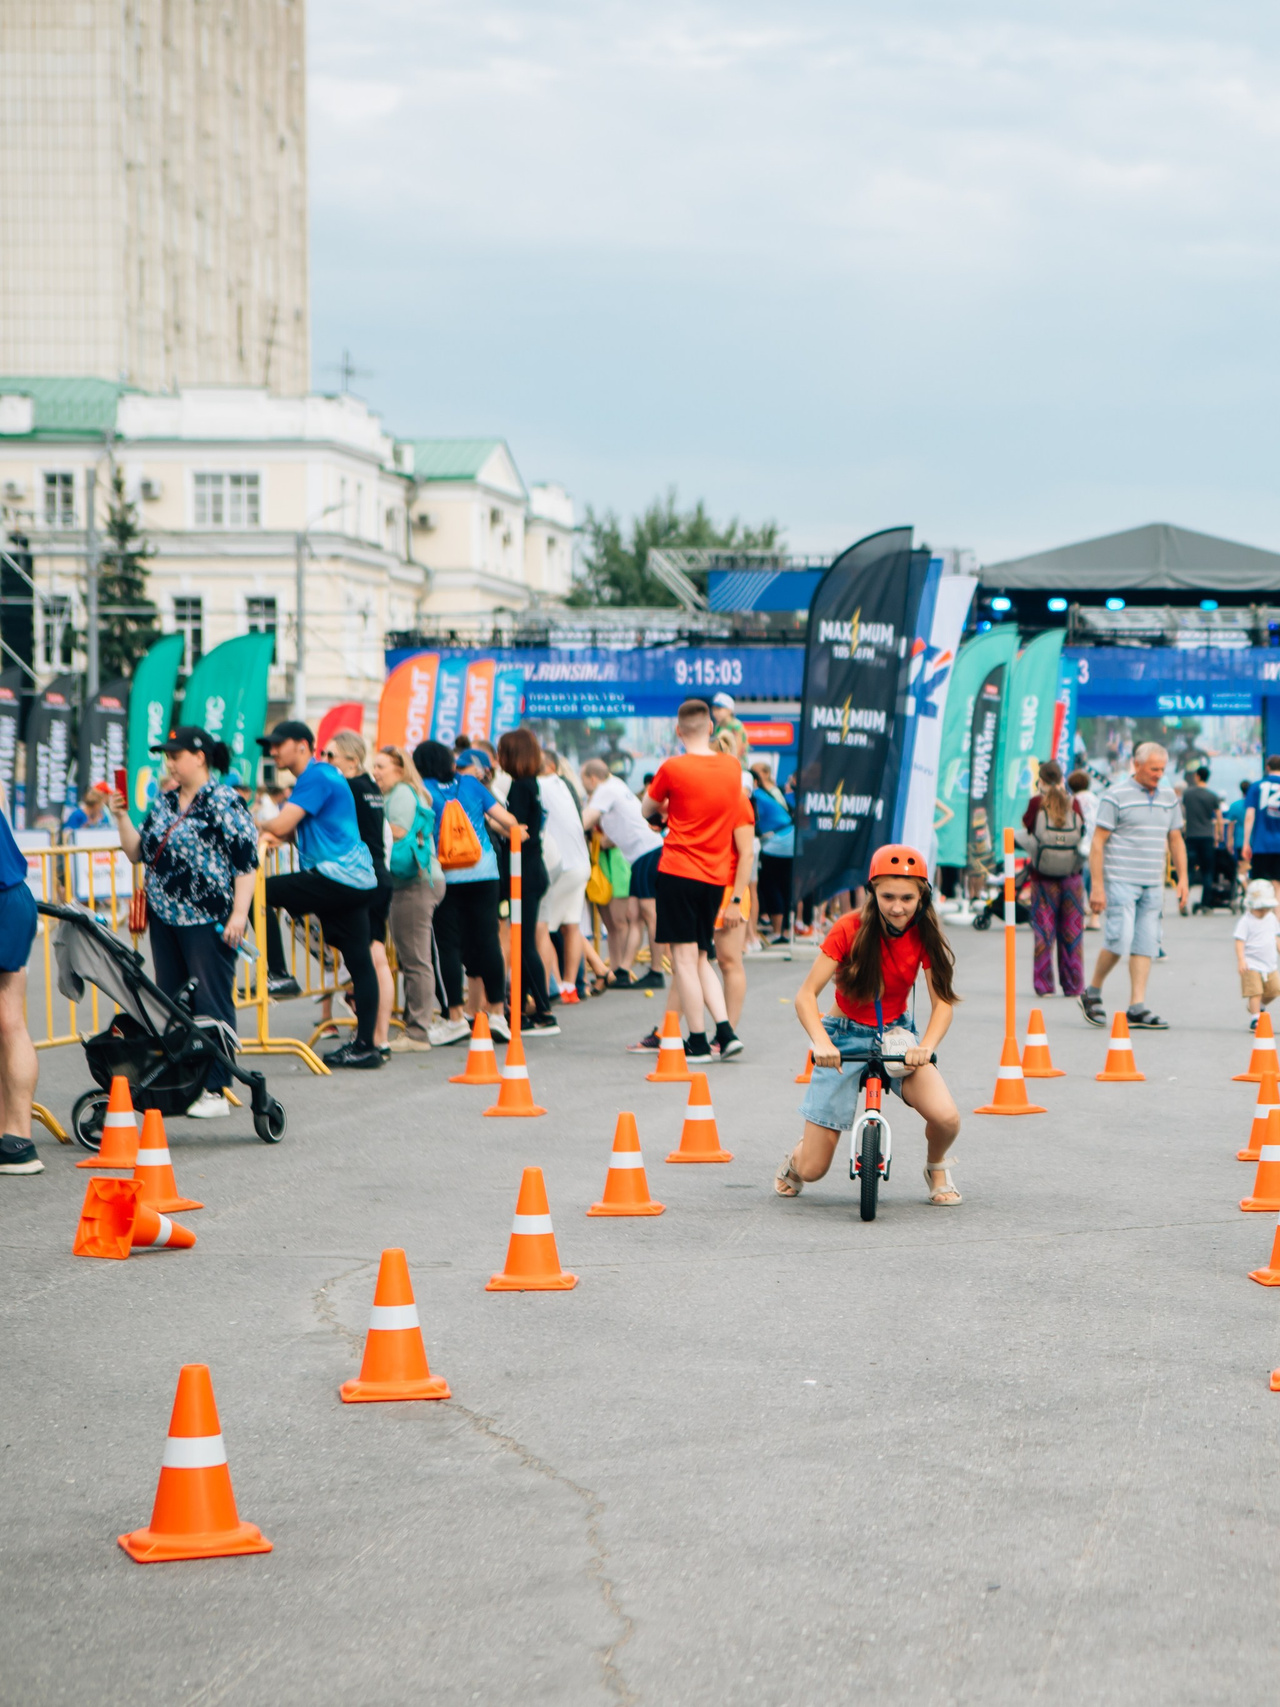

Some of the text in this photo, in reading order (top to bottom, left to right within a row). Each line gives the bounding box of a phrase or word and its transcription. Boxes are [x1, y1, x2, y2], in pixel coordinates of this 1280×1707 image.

[819, 619, 894, 647] MAXIMUM
[674, 658, 743, 687] 9:15:03
[811, 705, 886, 733] MAXIMUM
